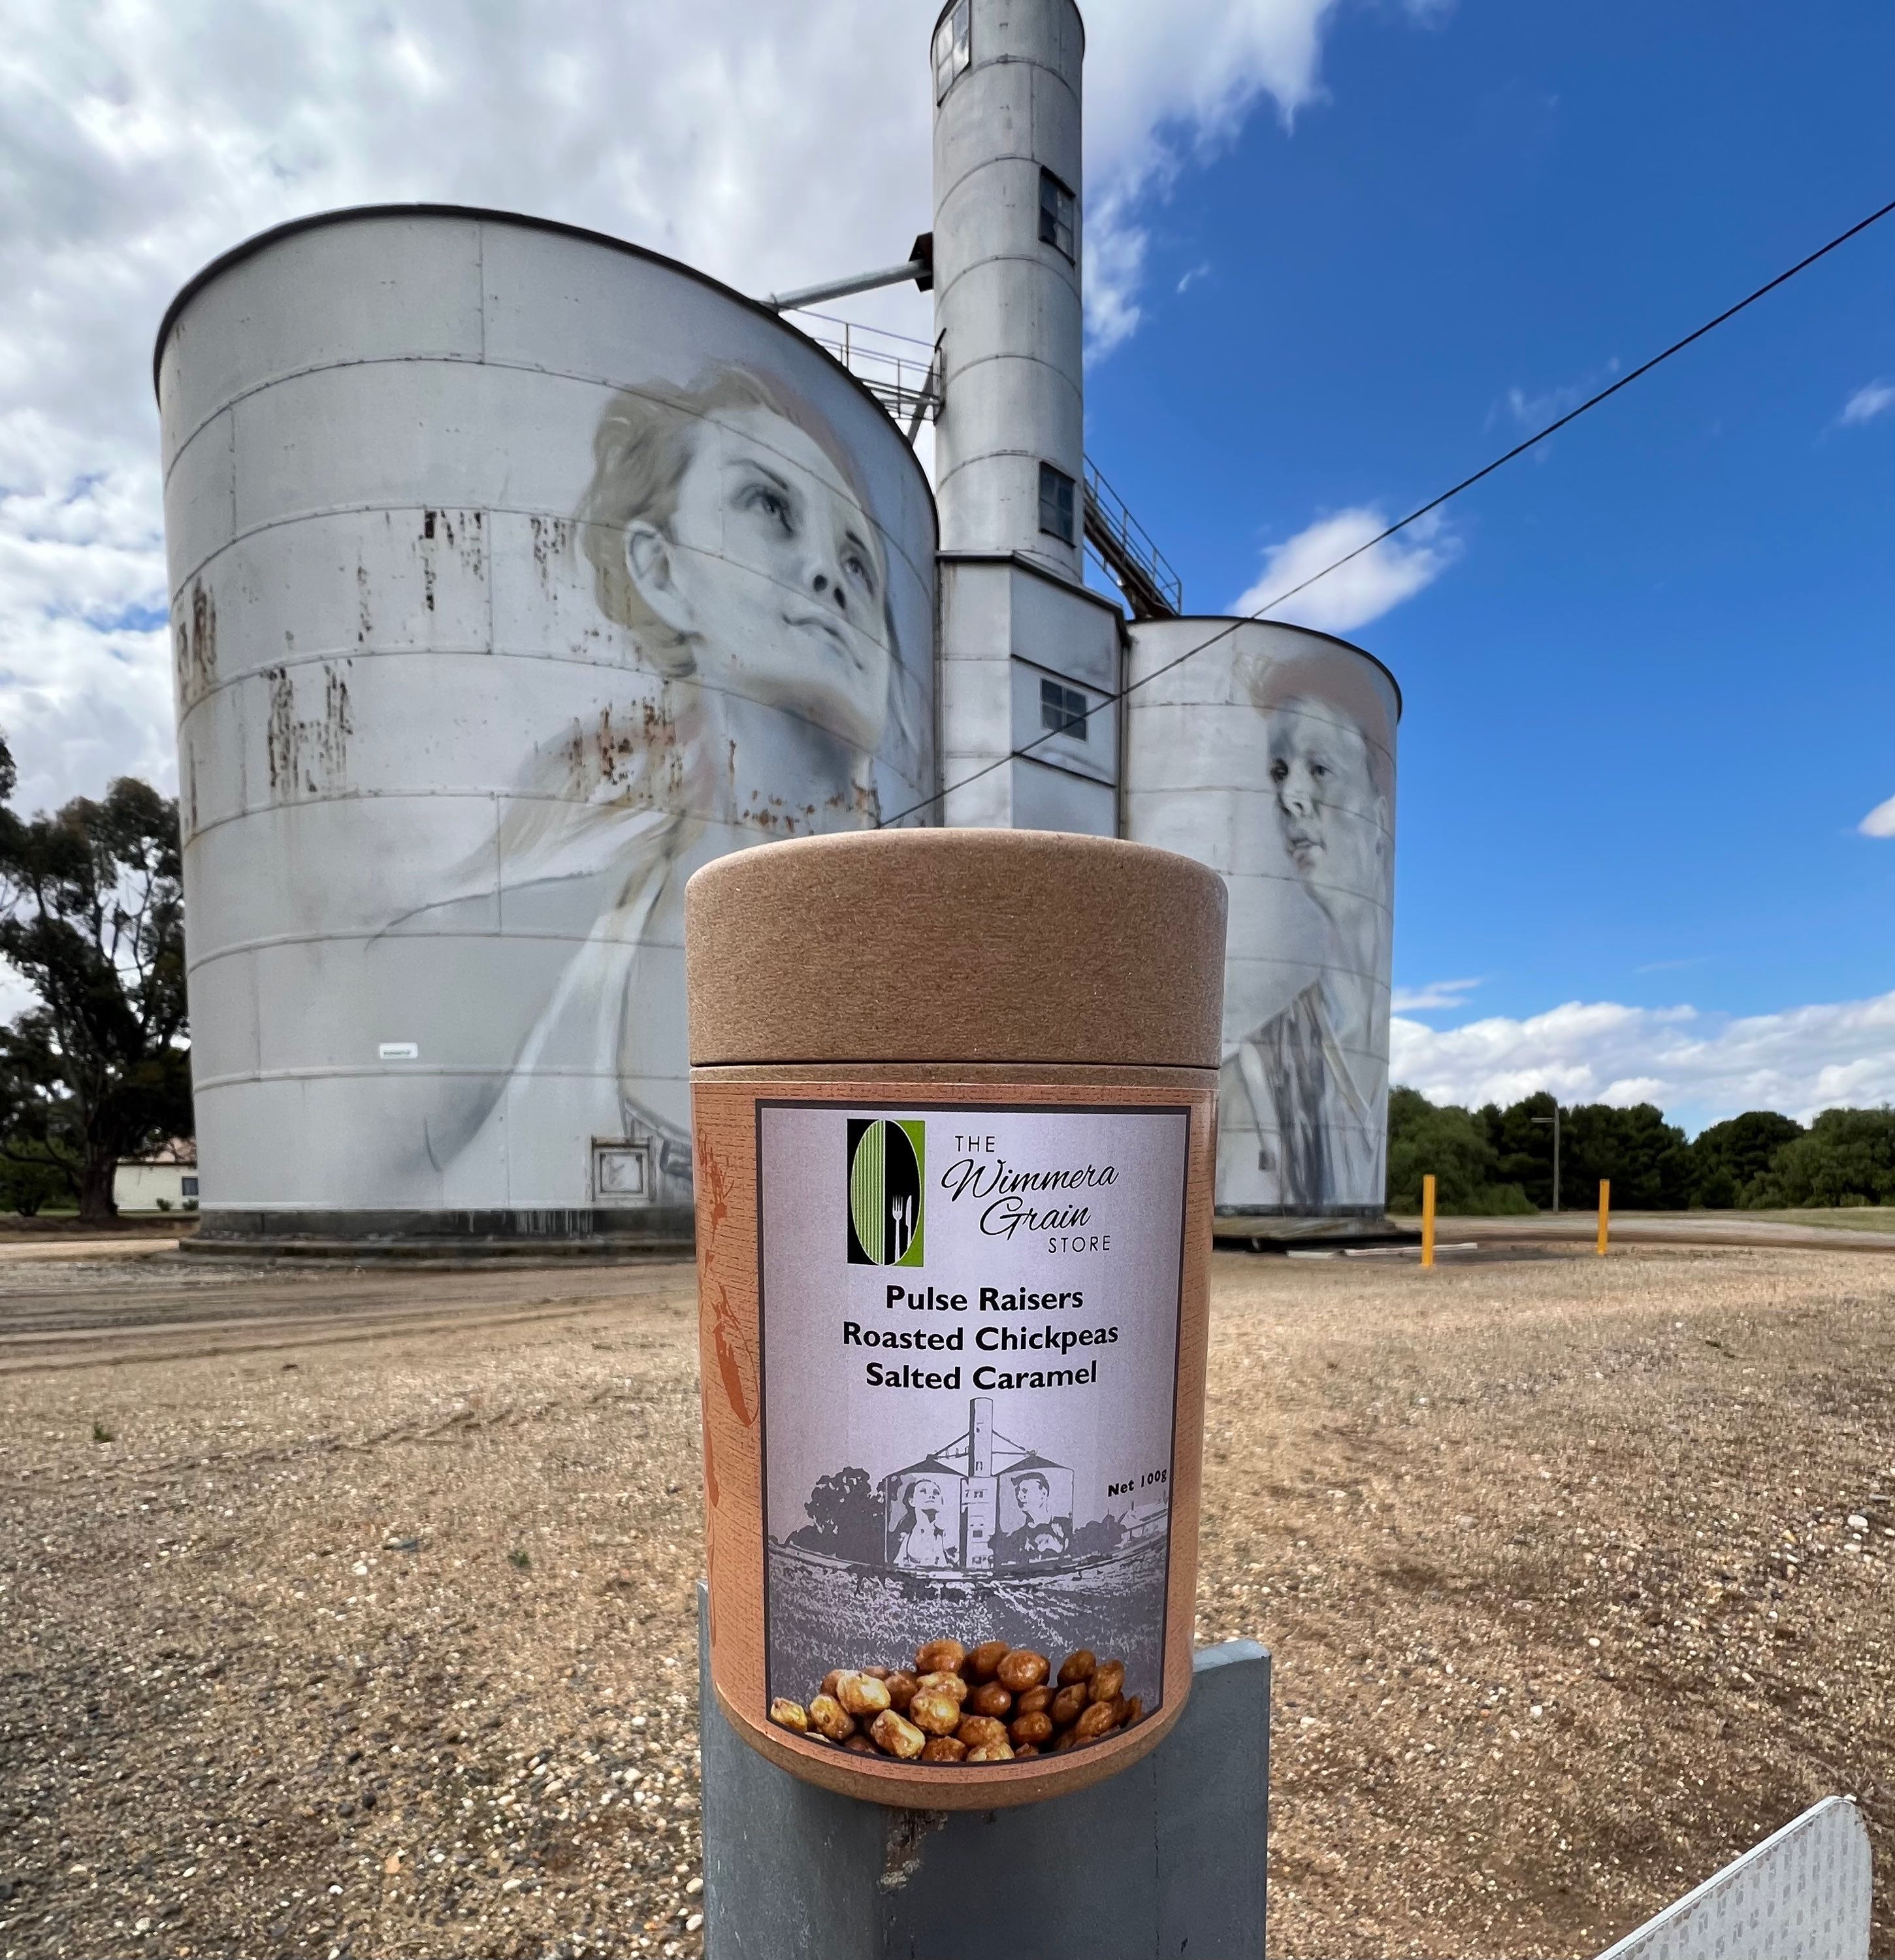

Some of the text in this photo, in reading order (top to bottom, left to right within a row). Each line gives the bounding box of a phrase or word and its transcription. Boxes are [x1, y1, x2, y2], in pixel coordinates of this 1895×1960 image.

[955, 1136, 995, 1152] THE
[941, 1159, 1119, 1201] Wimmera
[980, 1196, 1091, 1240] Grain
[1048, 1235, 1110, 1253] STORE
[887, 1285, 1083, 1311] Pulse Raisers
[844, 1322, 1118, 1355] Roasted Chickpeas
[867, 1360, 1096, 1390] Salted Caramel
[1108, 1469, 1167, 1497] Net 100g
